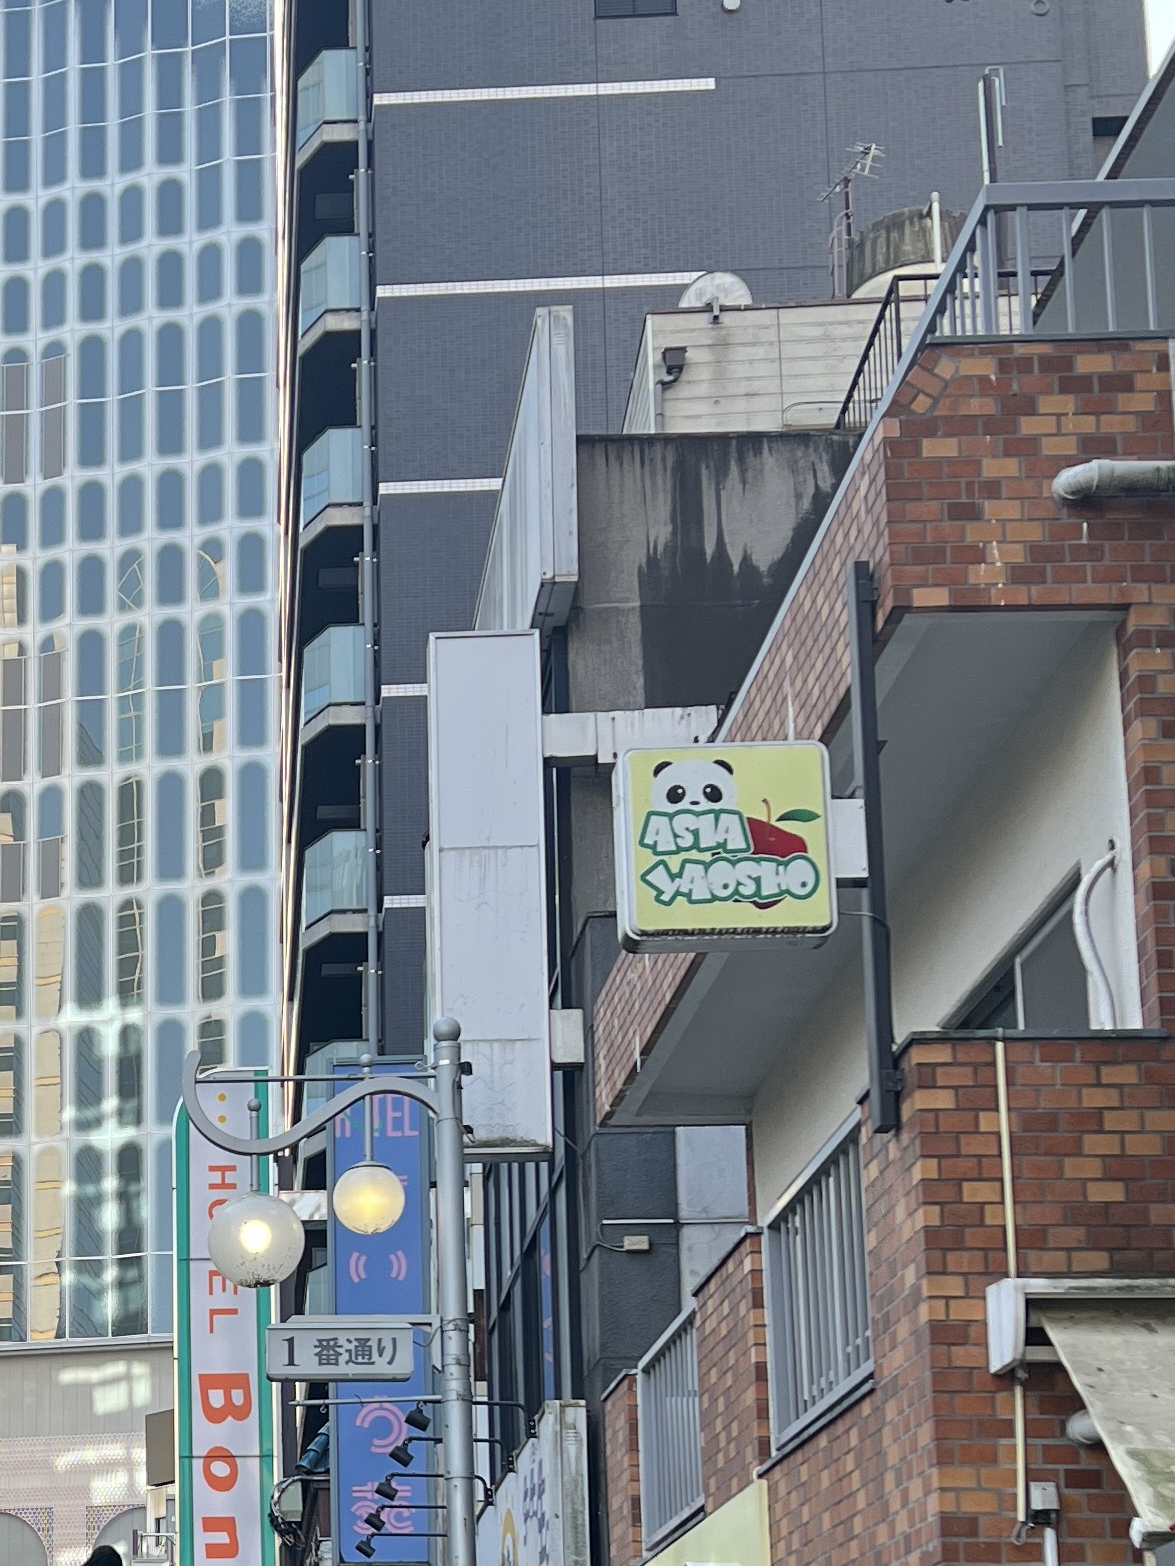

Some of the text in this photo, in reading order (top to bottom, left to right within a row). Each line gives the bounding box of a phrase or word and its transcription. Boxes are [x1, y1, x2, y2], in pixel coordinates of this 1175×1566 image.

[640, 810, 751, 854] ASIA
[641, 855, 820, 906] YAOSHO
[198, 1165, 253, 1560] HEL Bon
[281, 1336, 398, 1368] 1番通り
